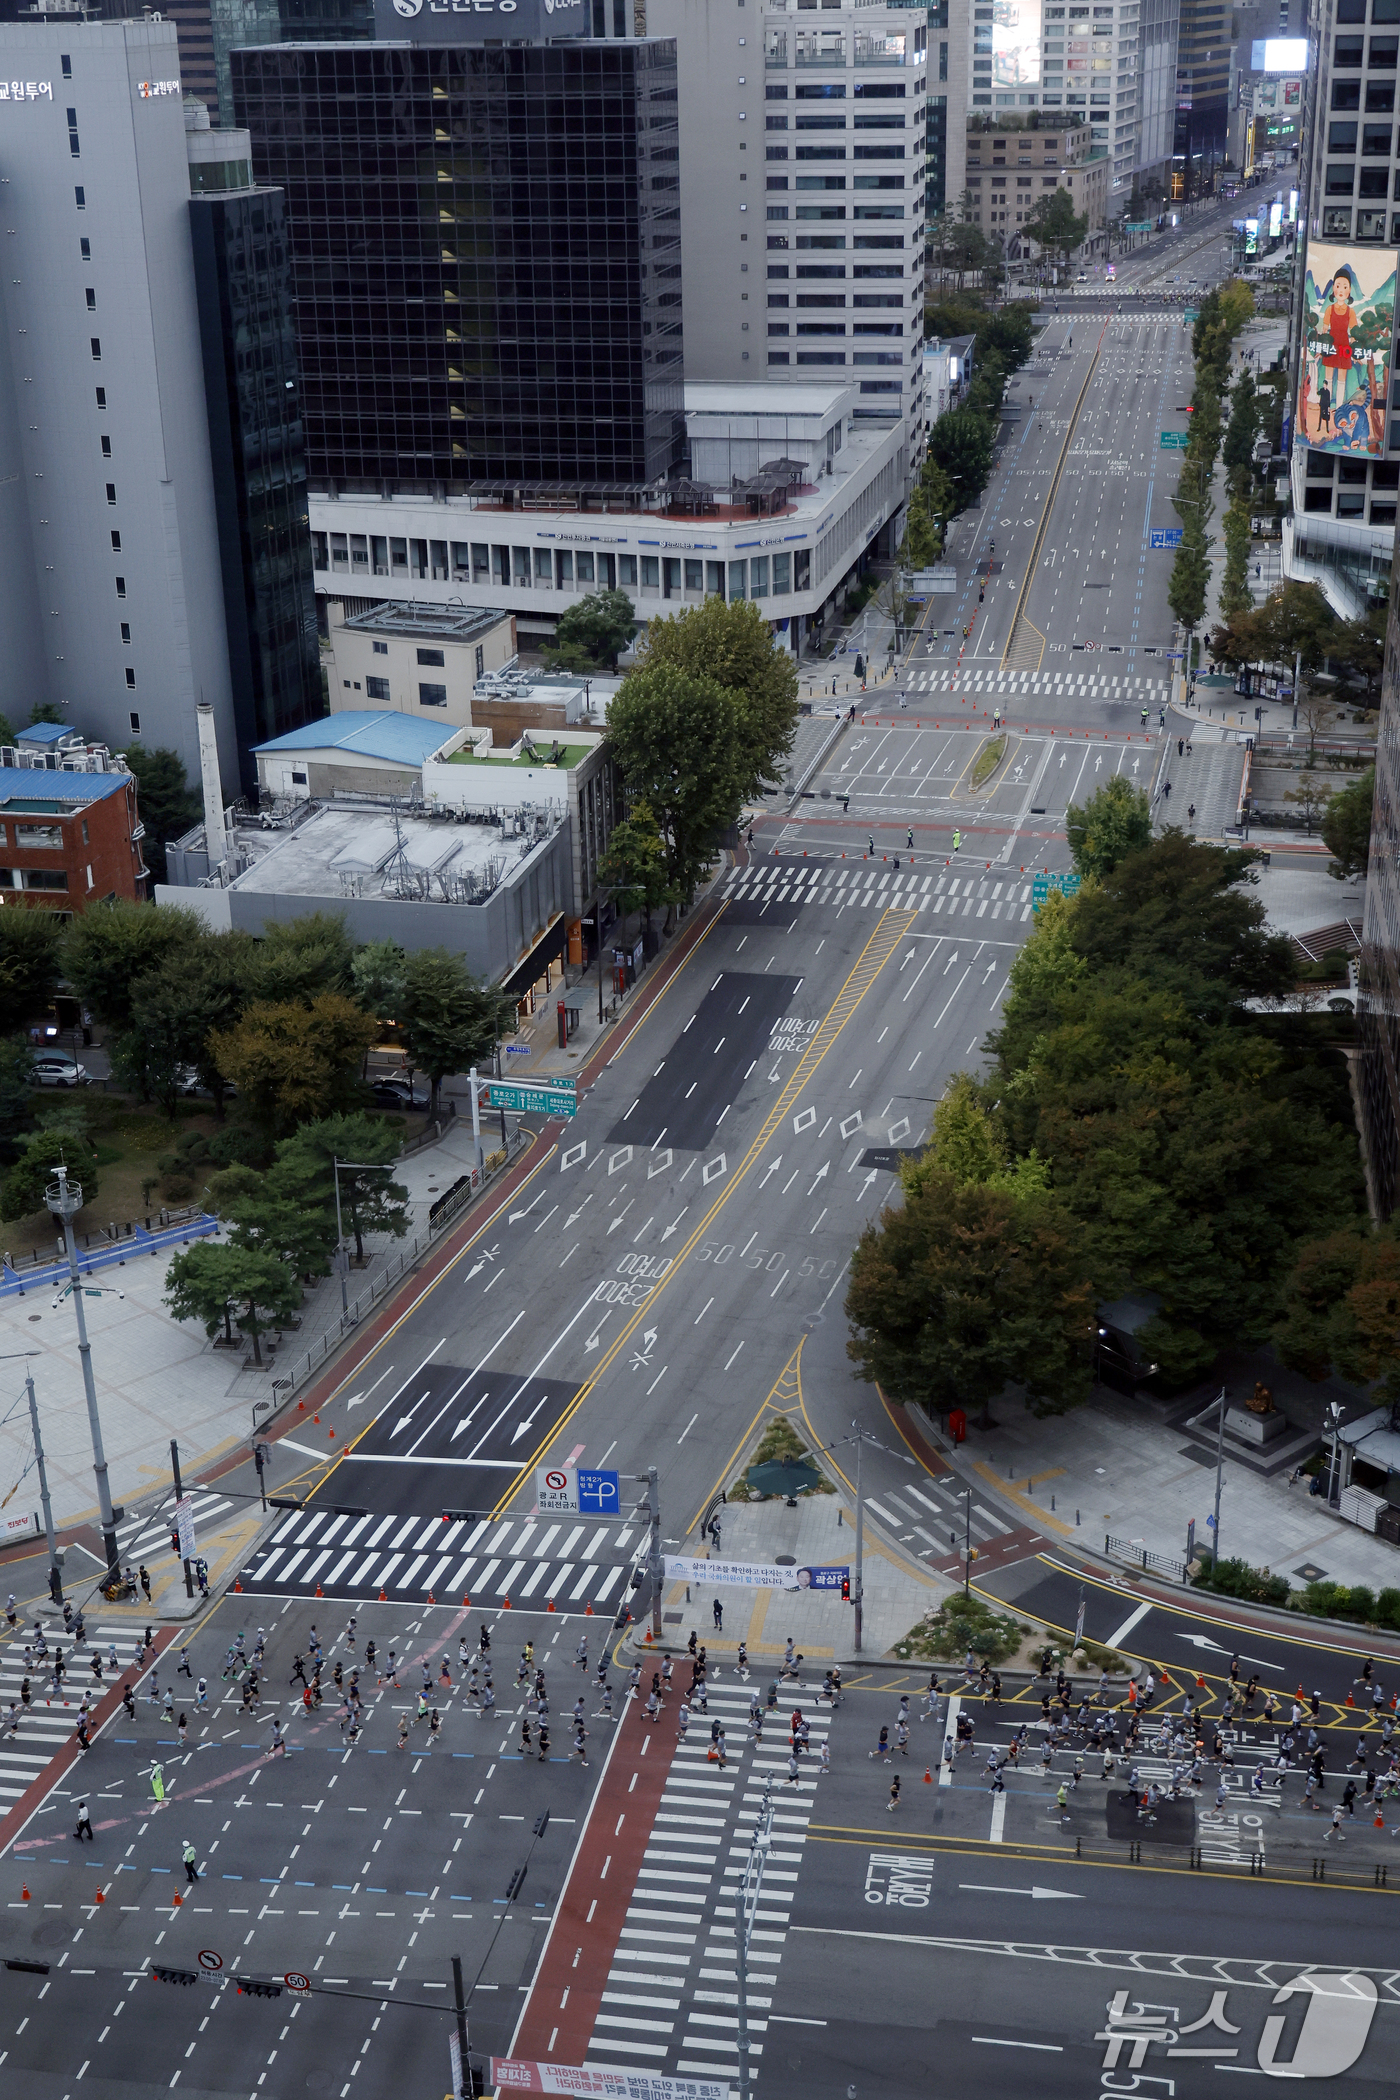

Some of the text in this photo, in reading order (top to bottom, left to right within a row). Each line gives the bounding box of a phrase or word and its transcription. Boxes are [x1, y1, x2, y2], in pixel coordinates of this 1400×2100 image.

[0, 81, 53, 101] 교원투어
[152, 80, 180, 96] 교원투어
[1309, 341, 1372, 360] 넷플릭스 10 주년
[1049, 643, 1066, 652] 50
[780, 1018, 819, 1034] 07:00
[768, 1036, 810, 1053] 23:00
[695, 1242, 735, 1264] 50
[746, 1249, 786, 1272] 50
[616, 1253, 673, 1279] 07:00
[595, 1280, 655, 1307] 23:00
[540, 1501, 577, 1510] 좌회전금지
[8, 1517, 28, 1529] 진보당
[692, 1562, 706, 1571] 삶의
[708, 1564, 729, 1573] 기초를
[731, 1566, 759, 1575] 확인하고
[761, 1569, 783, 1577] 다지는
[692, 1571, 706, 1579] 우리
[864, 1853, 935, 1908] 버스전용
[290, 1976, 305, 1986] 50
